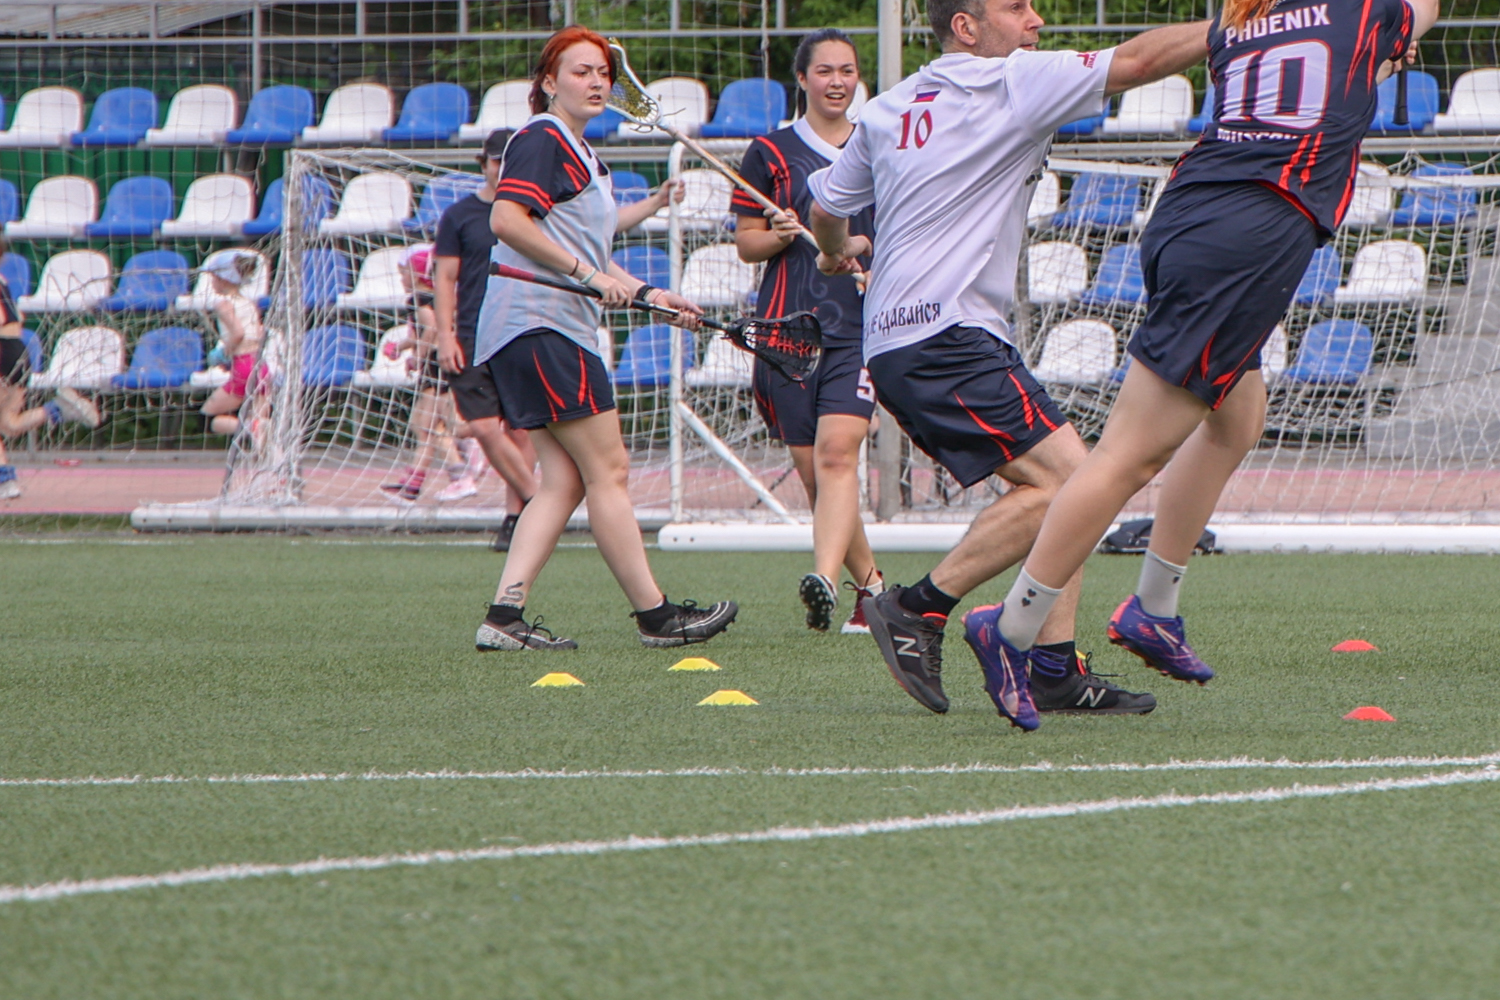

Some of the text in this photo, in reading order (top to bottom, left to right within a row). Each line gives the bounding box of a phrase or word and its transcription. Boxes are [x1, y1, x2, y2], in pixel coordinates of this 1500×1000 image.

[1224, 3, 1331, 48] PHOENIX
[1219, 38, 1332, 130] 10
[896, 108, 933, 150] 10
